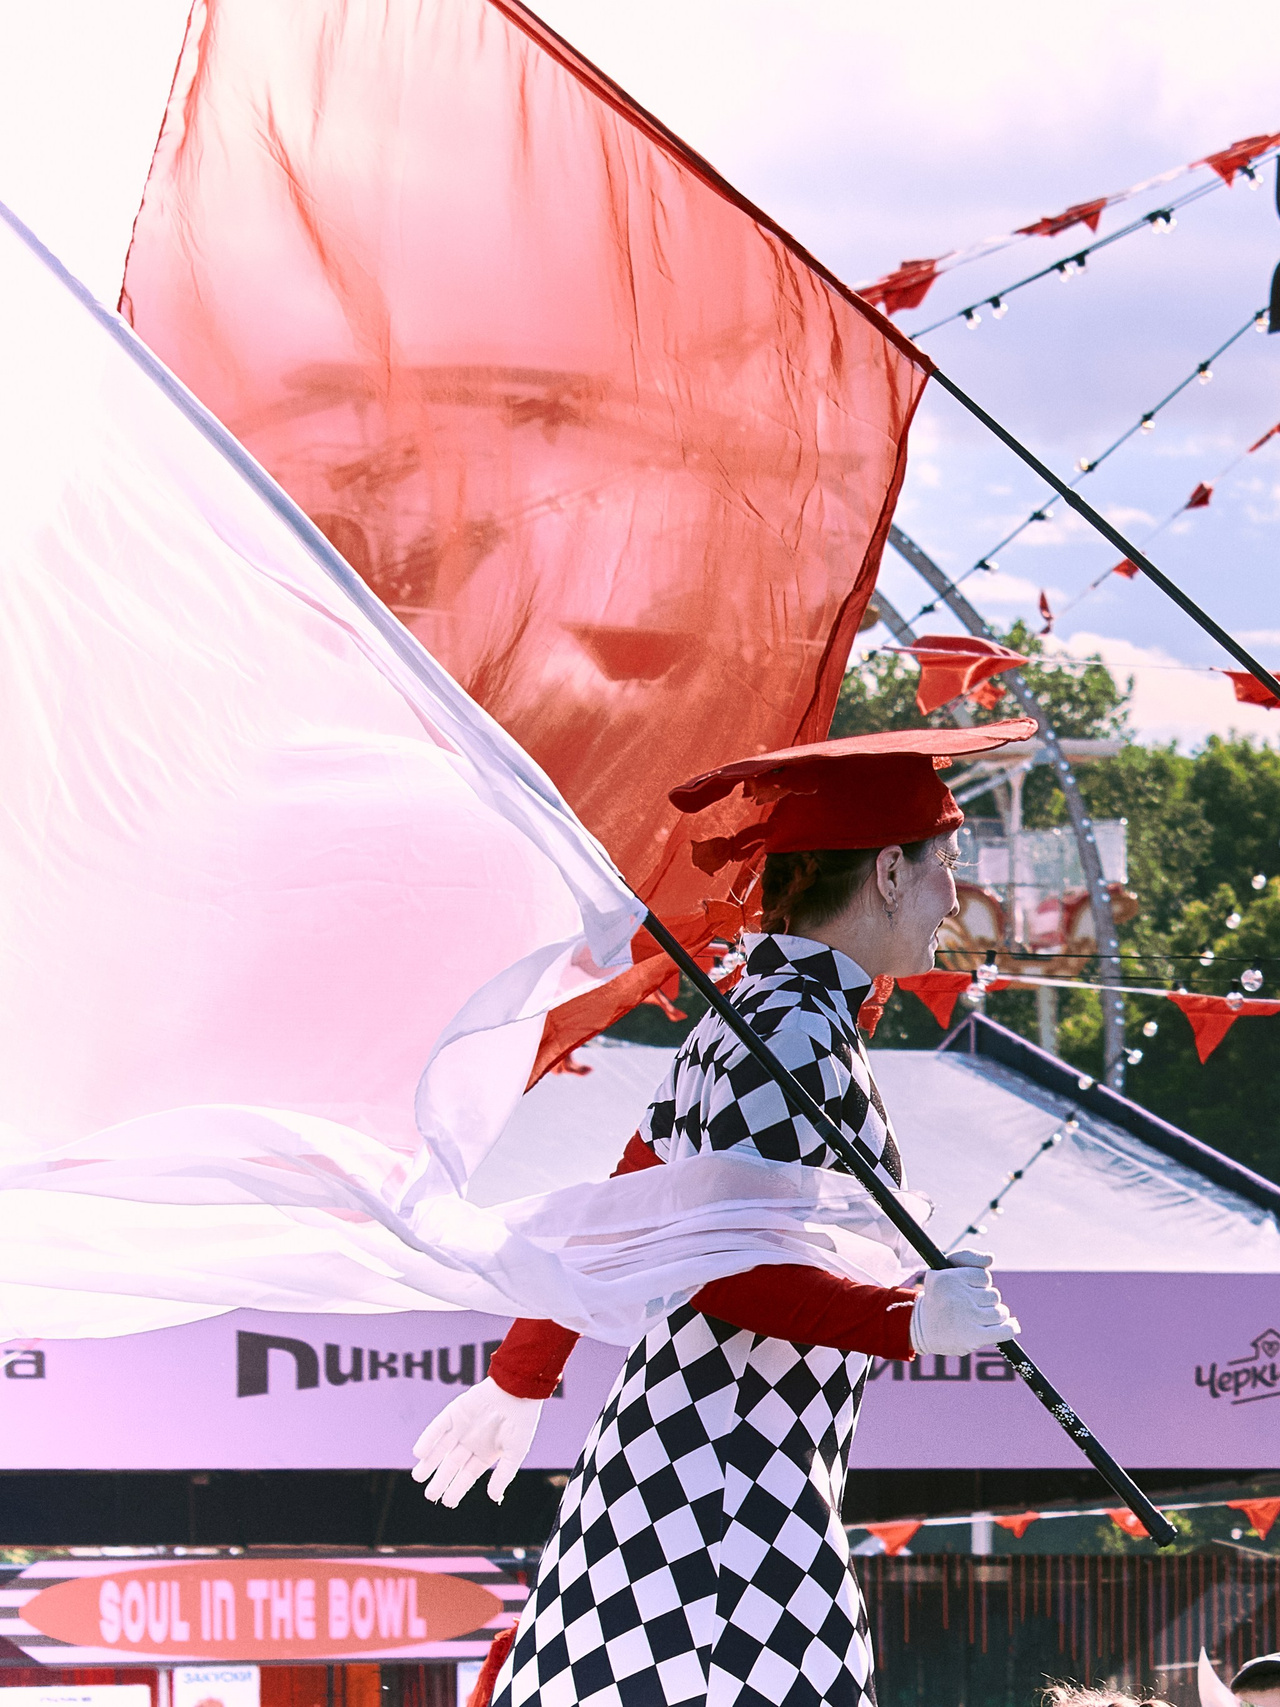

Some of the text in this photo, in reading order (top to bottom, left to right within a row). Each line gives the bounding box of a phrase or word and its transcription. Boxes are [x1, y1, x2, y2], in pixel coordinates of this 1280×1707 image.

[236, 1329, 564, 1398] Пикни
[99, 1579, 189, 1643] SOUL
[247, 1577, 316, 1640] THE
[328, 1576, 427, 1640] BOWL
